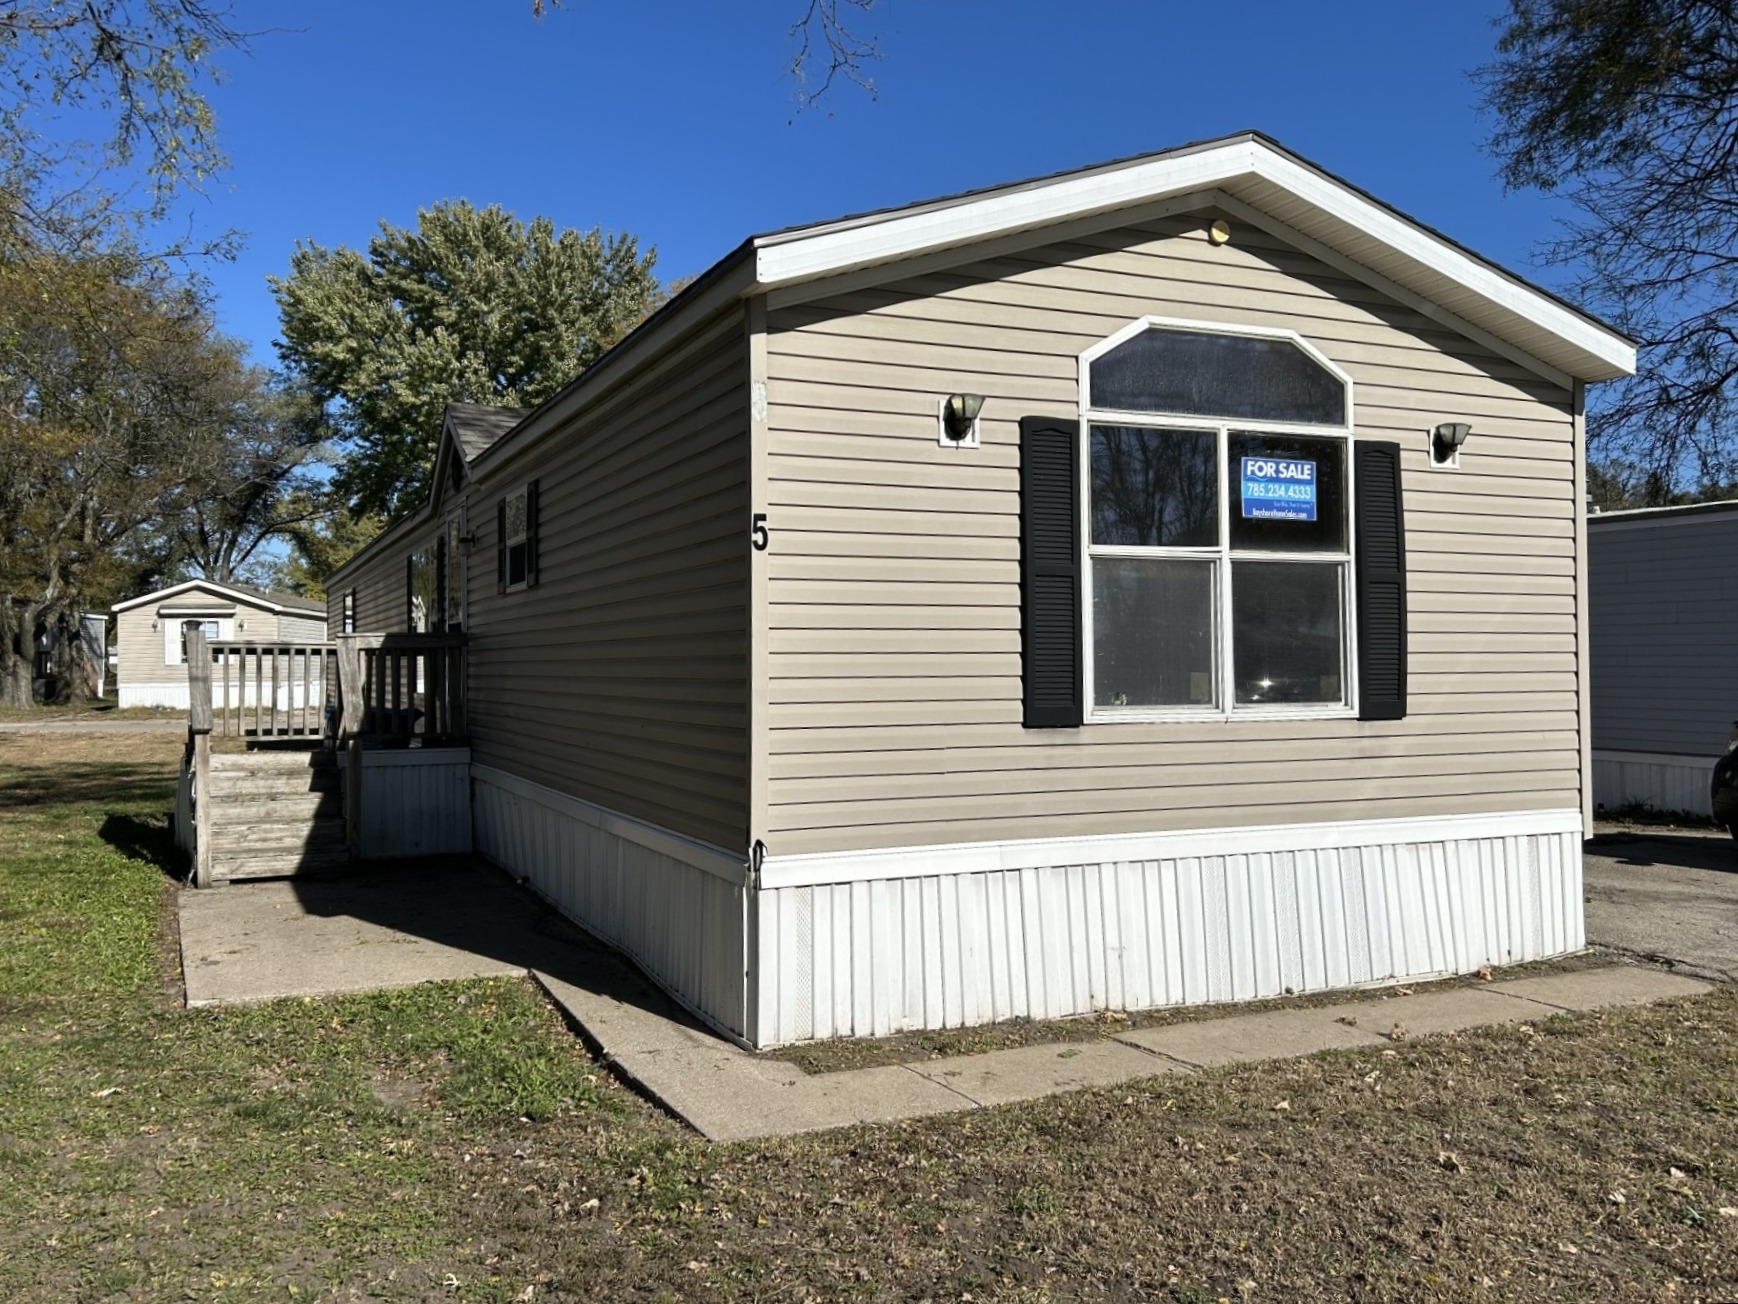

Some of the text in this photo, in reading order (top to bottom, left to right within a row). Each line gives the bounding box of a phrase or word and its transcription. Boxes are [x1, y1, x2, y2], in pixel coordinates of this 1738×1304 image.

[1247, 460, 1311, 480] FOR SALE
[1247, 483, 1311, 499] 785.234.4333
[752, 513, 769, 551] 5
